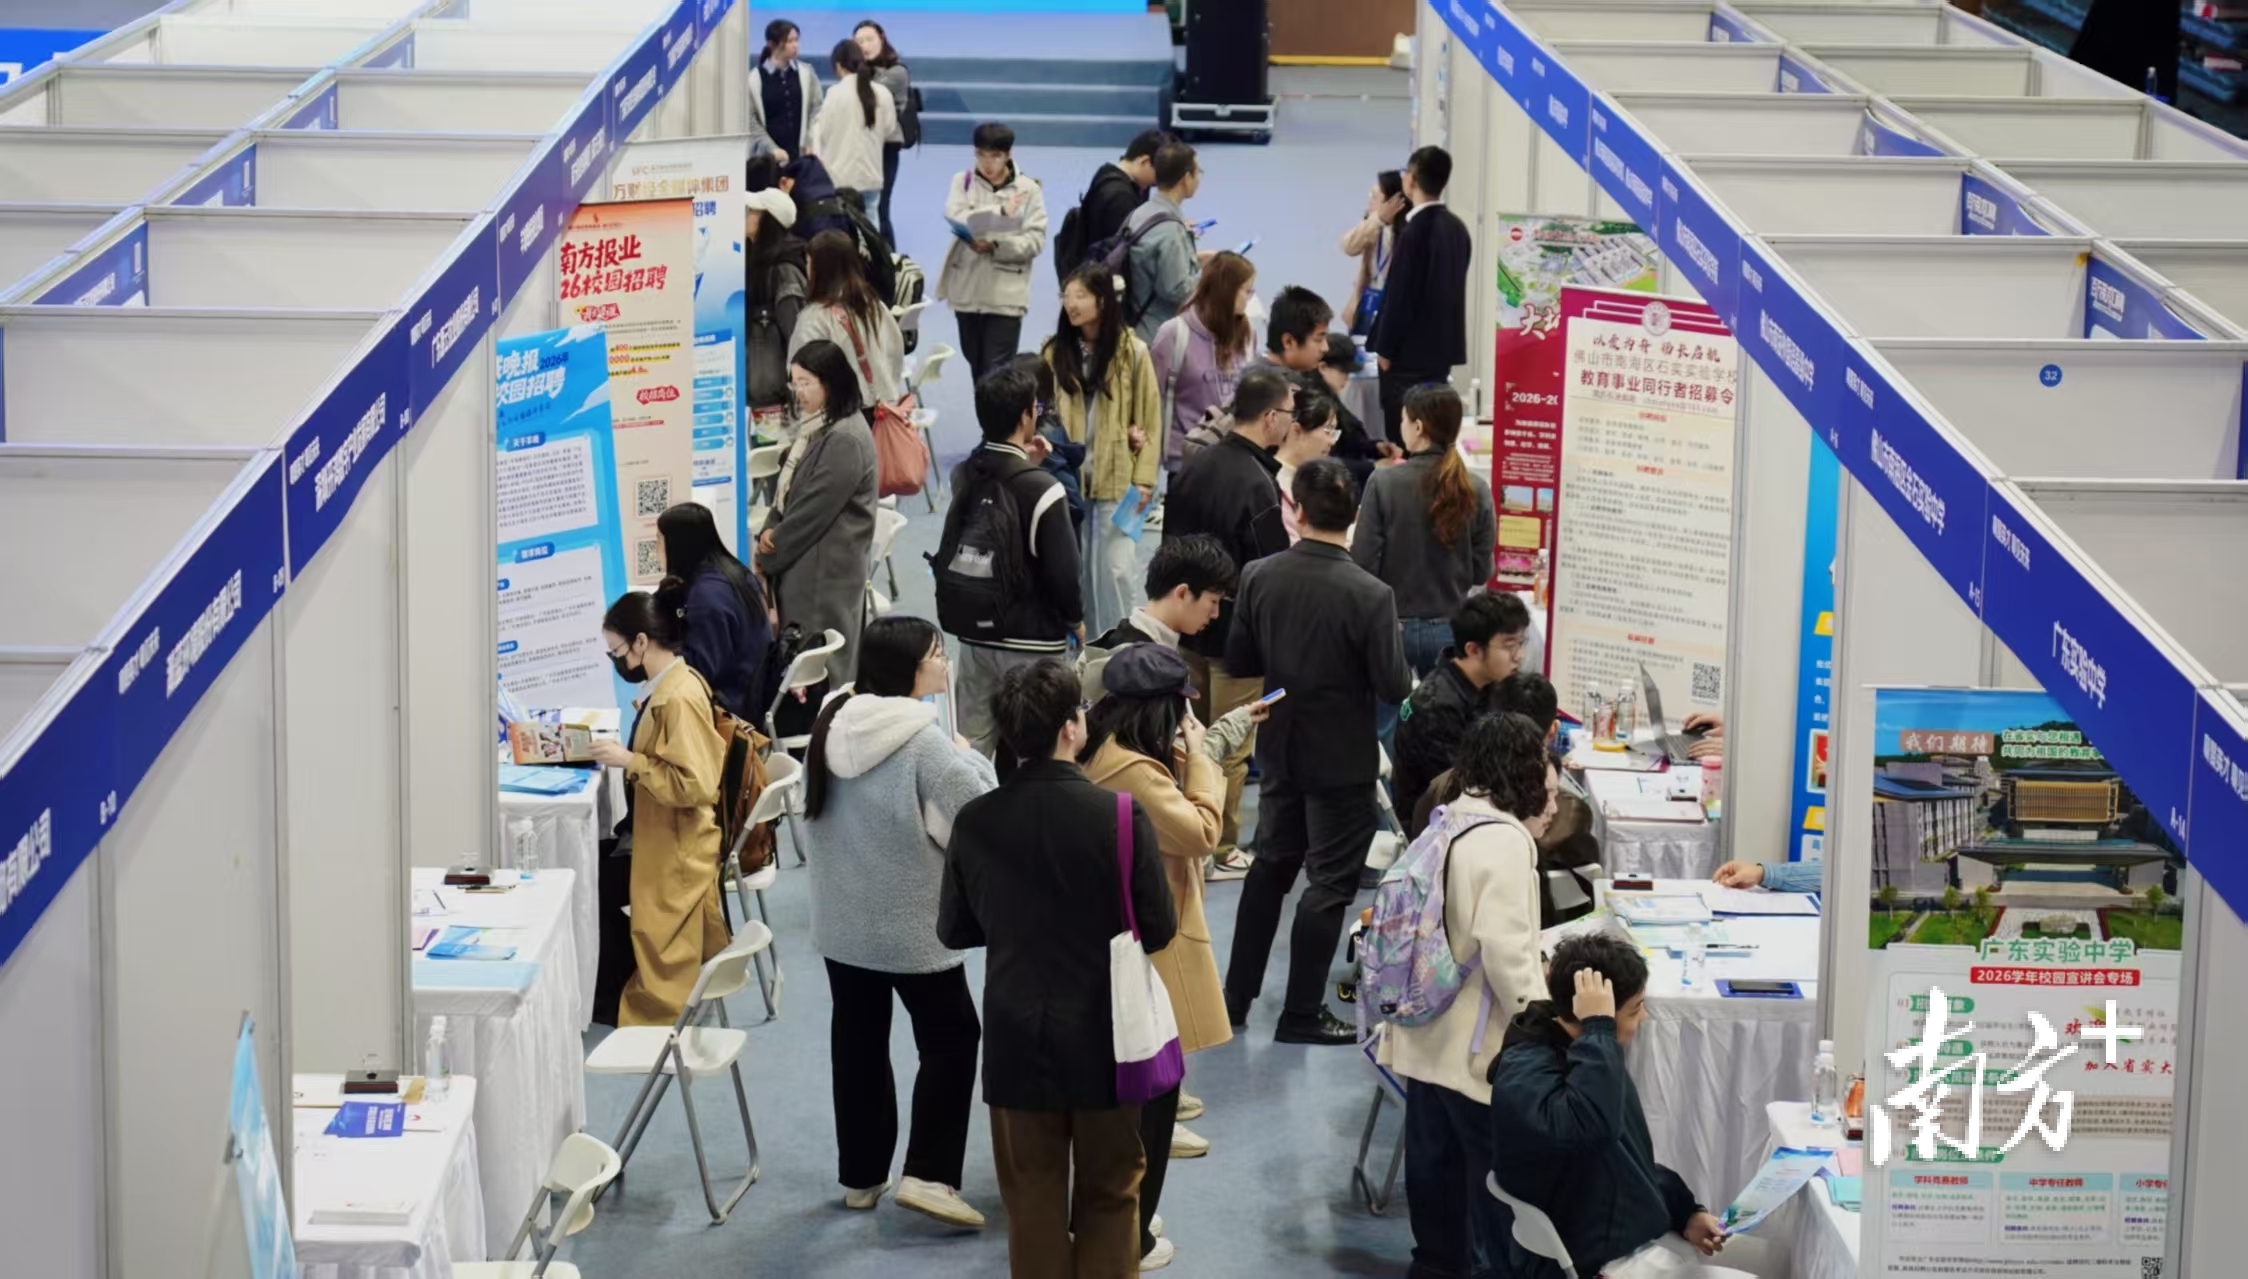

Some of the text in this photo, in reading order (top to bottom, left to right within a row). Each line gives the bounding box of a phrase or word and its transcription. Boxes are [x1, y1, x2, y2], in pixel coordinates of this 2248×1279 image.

[560, 234, 641, 275] 南方报业
[560, 264, 668, 300] 26校园招聘
[1581, 370, 1735, 404] 教育事业同行者招募令
[2044, 370, 2058, 381] 32
[2052, 620, 2106, 710] 广东实验中学
[2170, 806, 2186, 841] A-14
[1980, 937, 2134, 964] 广东实验中学
[1977, 969, 2134, 986] 2026学年校园宣讲会专场
